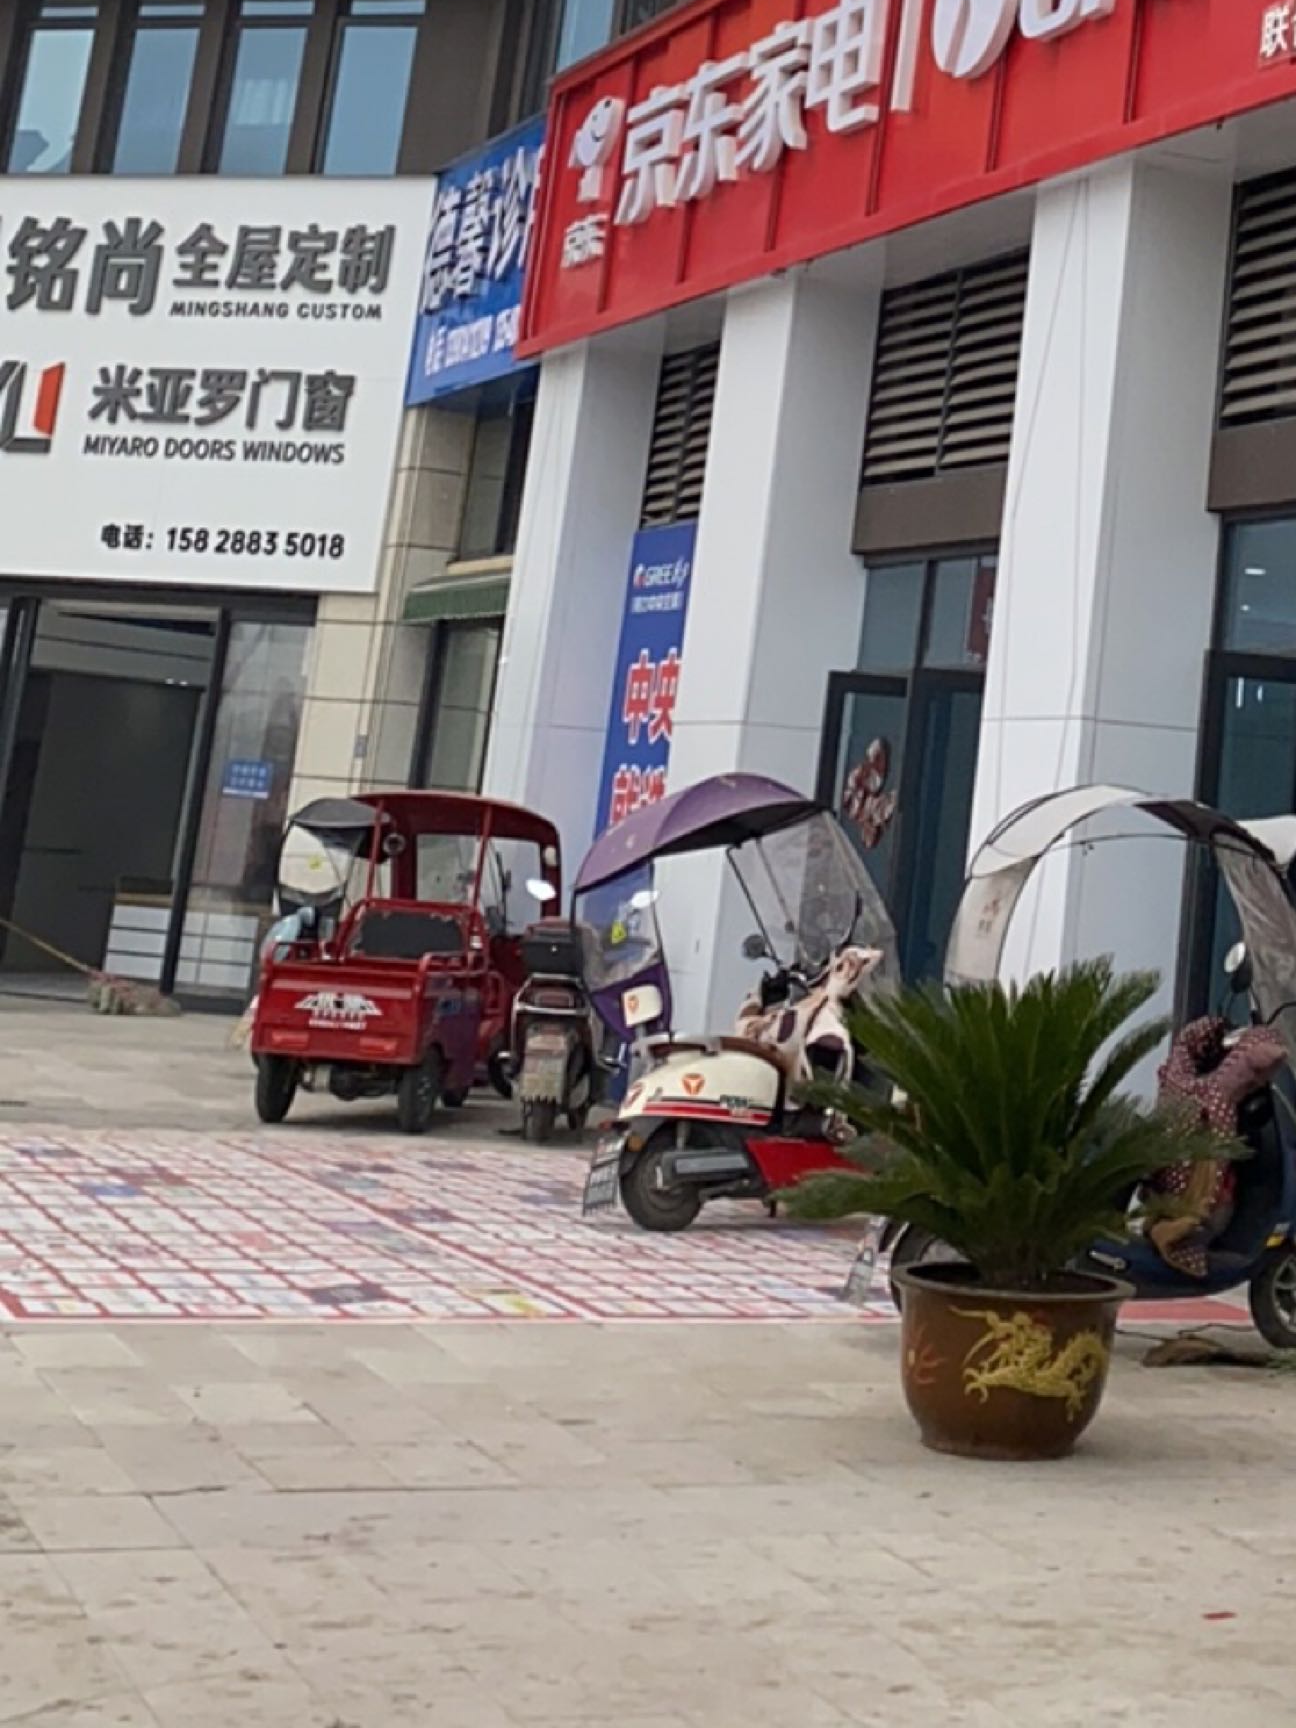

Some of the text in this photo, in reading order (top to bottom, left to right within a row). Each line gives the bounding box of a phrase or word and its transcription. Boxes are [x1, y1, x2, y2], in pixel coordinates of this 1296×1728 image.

[6, 216, 397, 316] 铭尚 全屋定制
[168, 301, 382, 320] MINGSHANG CUSTOM
[88, 364, 356, 432] 米亚罗门窗
[83, 434, 345, 465] MIYARO DOORS WINDOWS
[166, 527, 208, 552] 158
[214, 529, 279, 556] 2883
[284, 532, 345, 559] 5018
